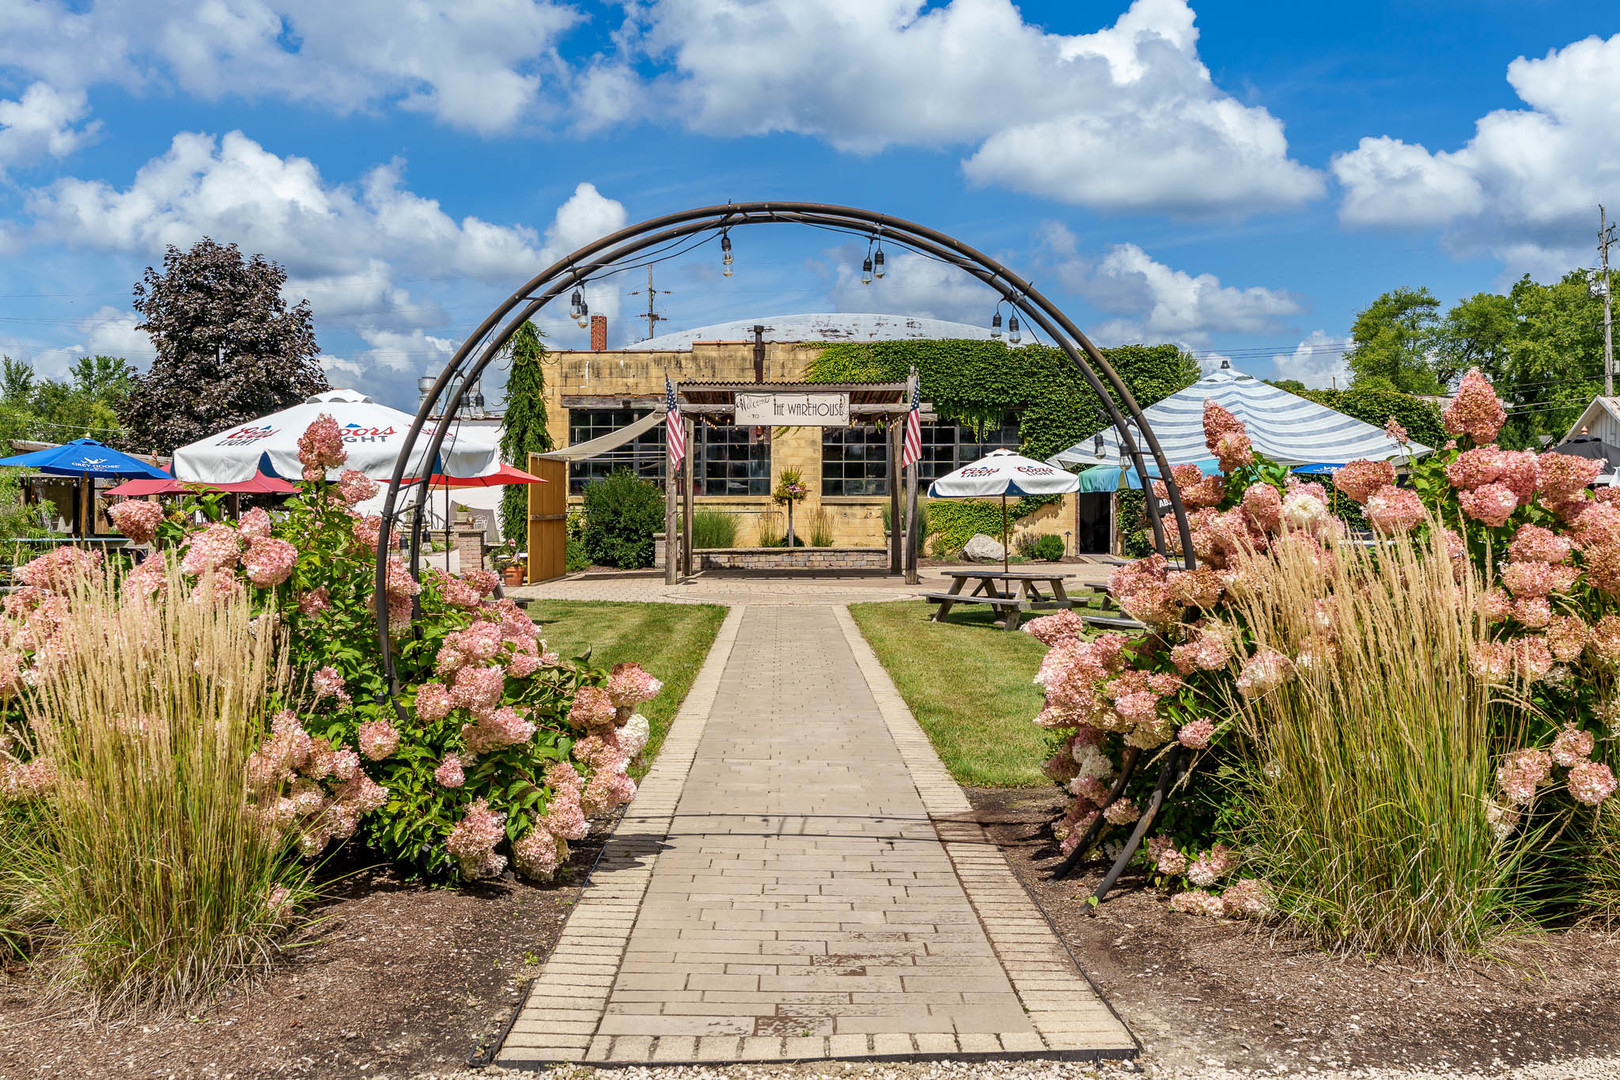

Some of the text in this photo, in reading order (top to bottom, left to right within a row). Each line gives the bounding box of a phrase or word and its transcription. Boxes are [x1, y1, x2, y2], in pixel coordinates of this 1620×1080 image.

[773, 402, 848, 418] THE WAREHOUSE
[339, 426, 397, 437] oors
[215, 438, 260, 446] LIGHT
[343, 435, 388, 443] GHT
